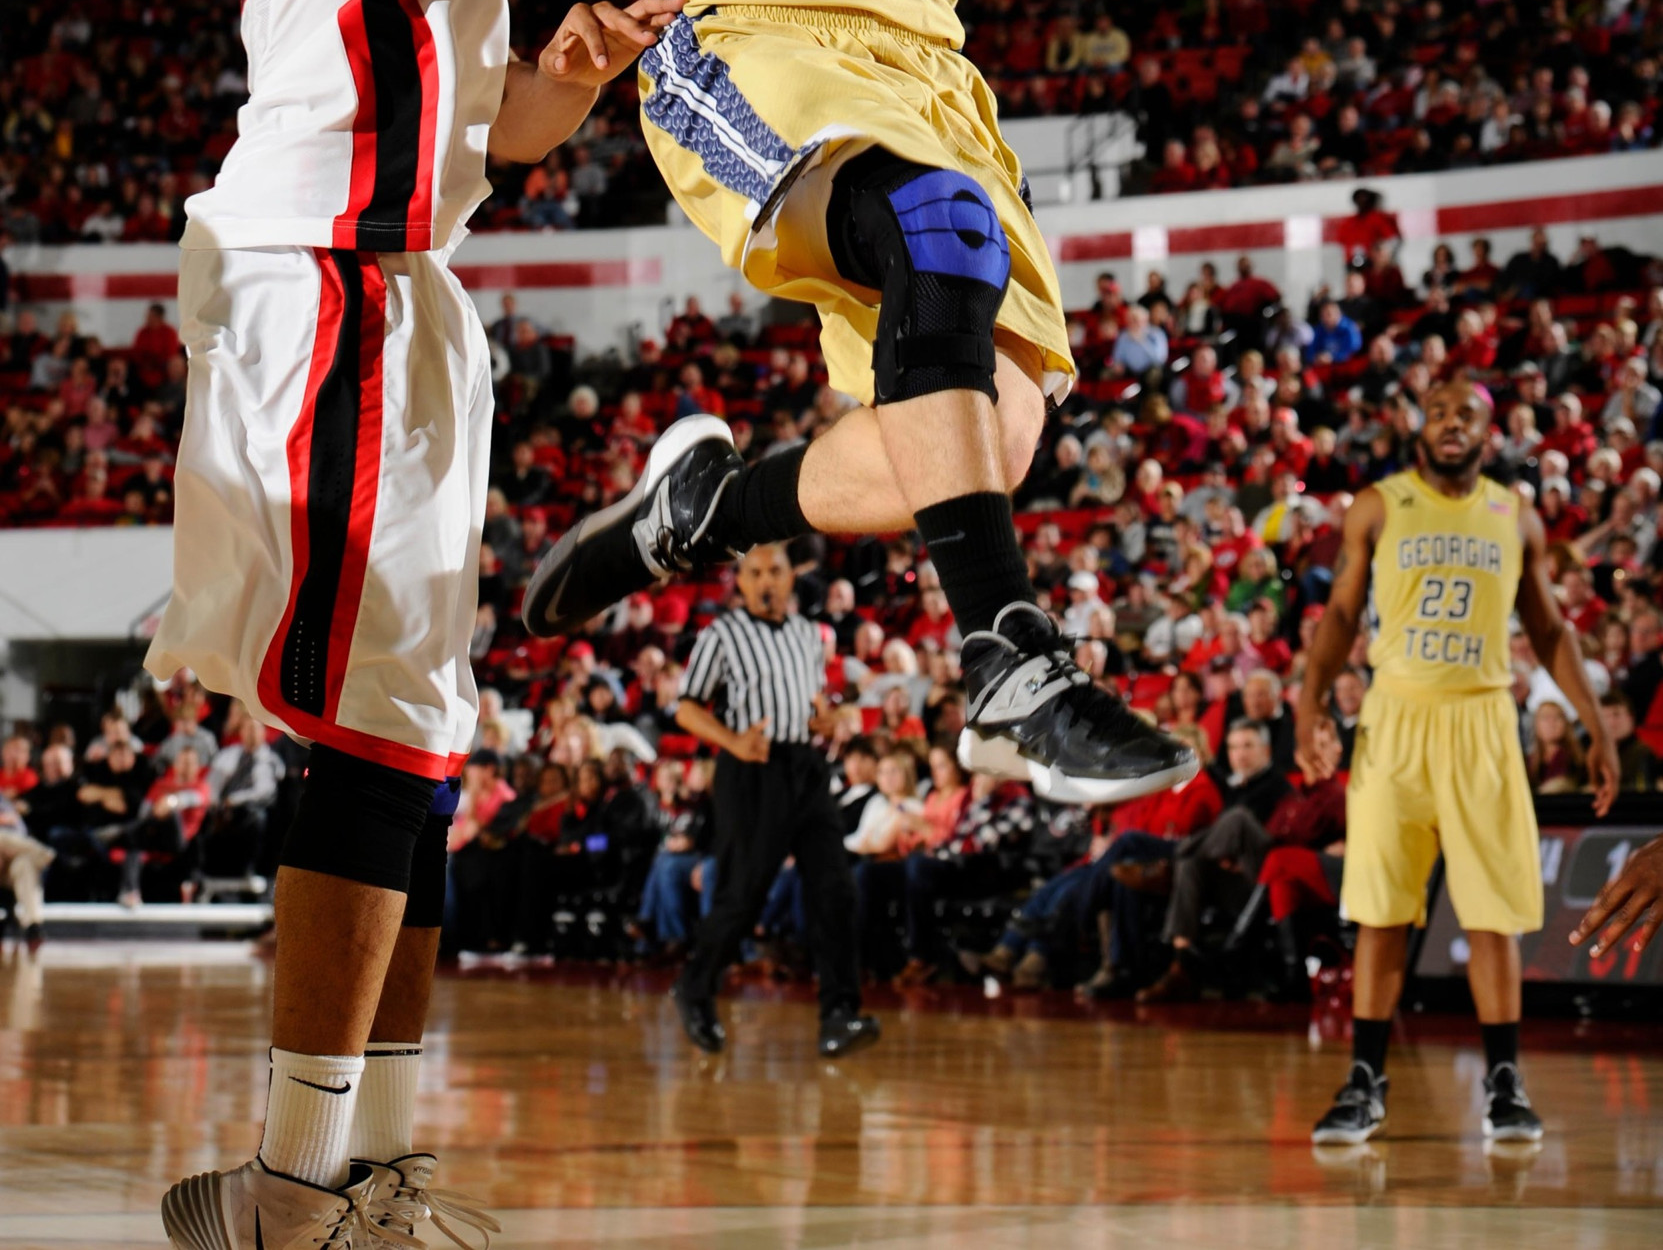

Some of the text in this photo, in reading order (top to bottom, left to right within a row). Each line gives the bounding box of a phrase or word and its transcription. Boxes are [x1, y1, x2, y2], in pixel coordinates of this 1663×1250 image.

[1397, 533, 1502, 575] GEORGIA
[1418, 576, 1473, 621] 23
[1404, 627, 1485, 666] TECH
